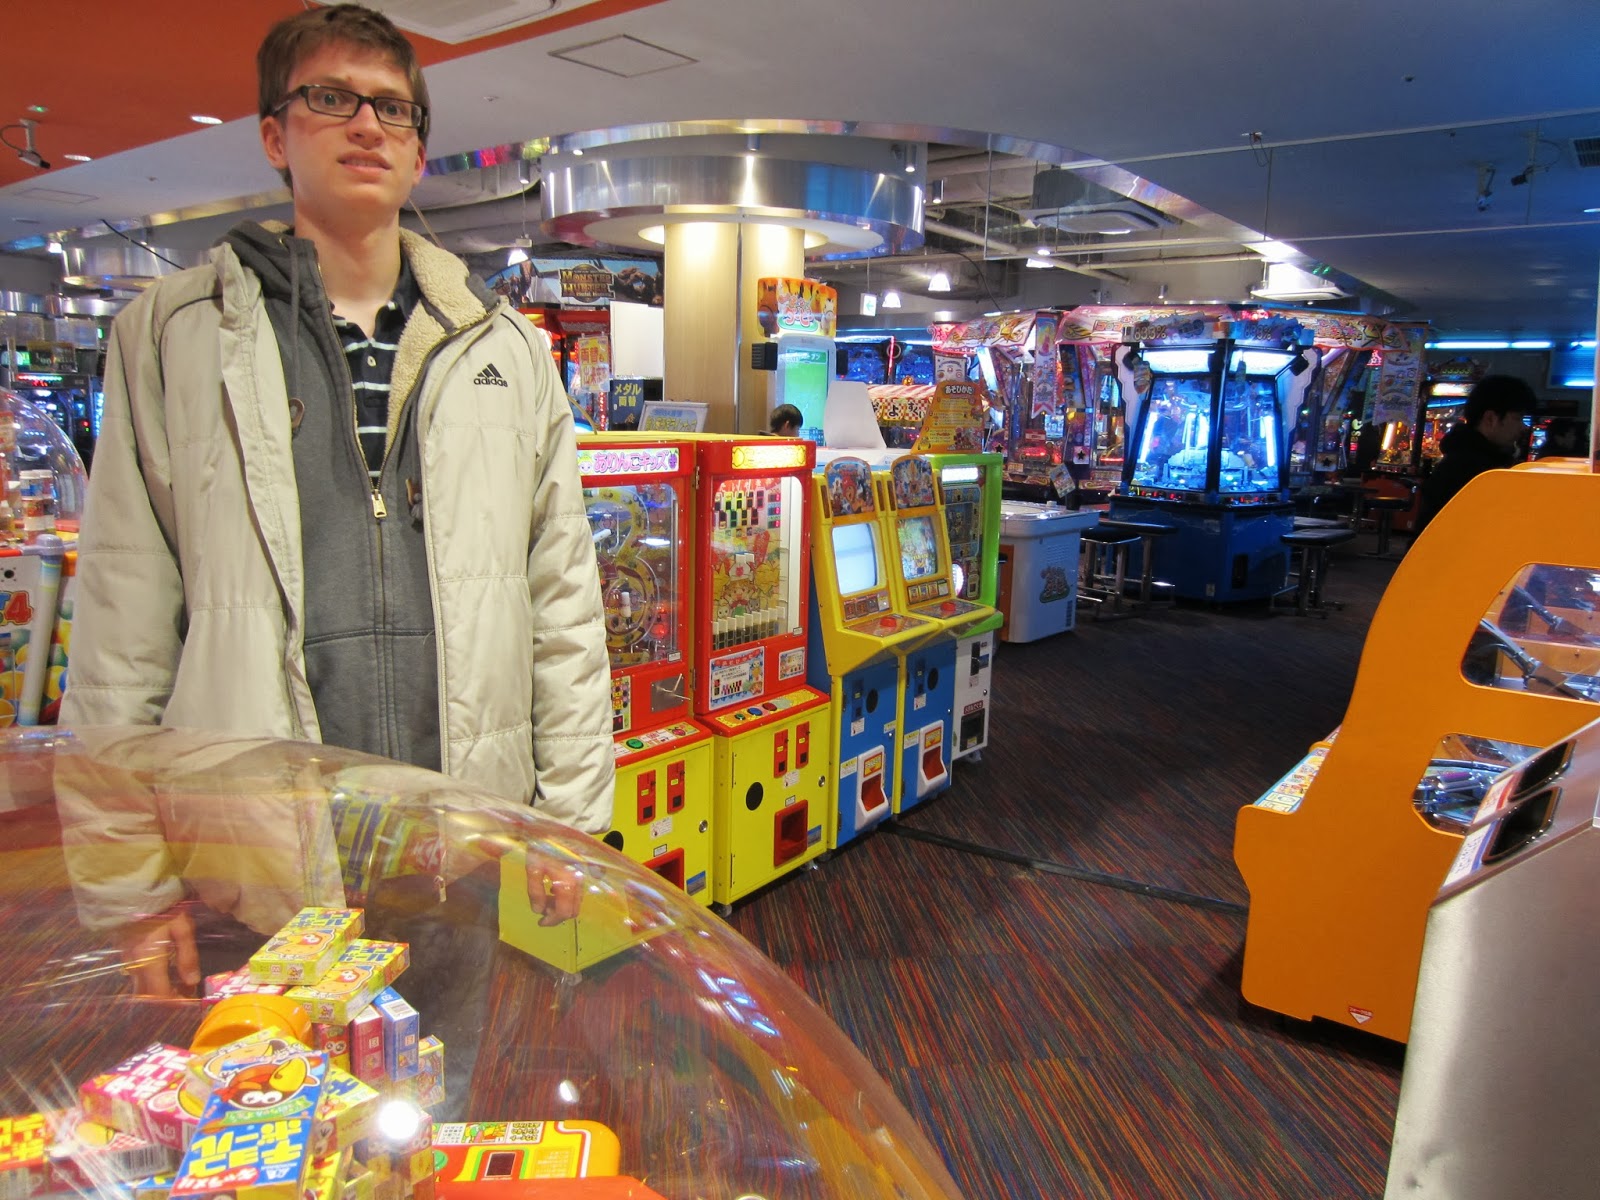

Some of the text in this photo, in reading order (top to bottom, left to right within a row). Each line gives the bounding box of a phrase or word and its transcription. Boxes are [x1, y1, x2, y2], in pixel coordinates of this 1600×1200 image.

[473, 377, 508, 388] adidas
[614, 383, 642, 395] メダル
[618, 395, 637, 407] 両替
[593, 450, 670, 474] ありんこキッズ
[297, 911, 351, 920] チョコ
[289, 919, 347, 928] ボール
[103, 1048, 181, 1095] チョコ
[190, 1119, 303, 1160] ボール
[188, 1137, 303, 1178] チョコ
